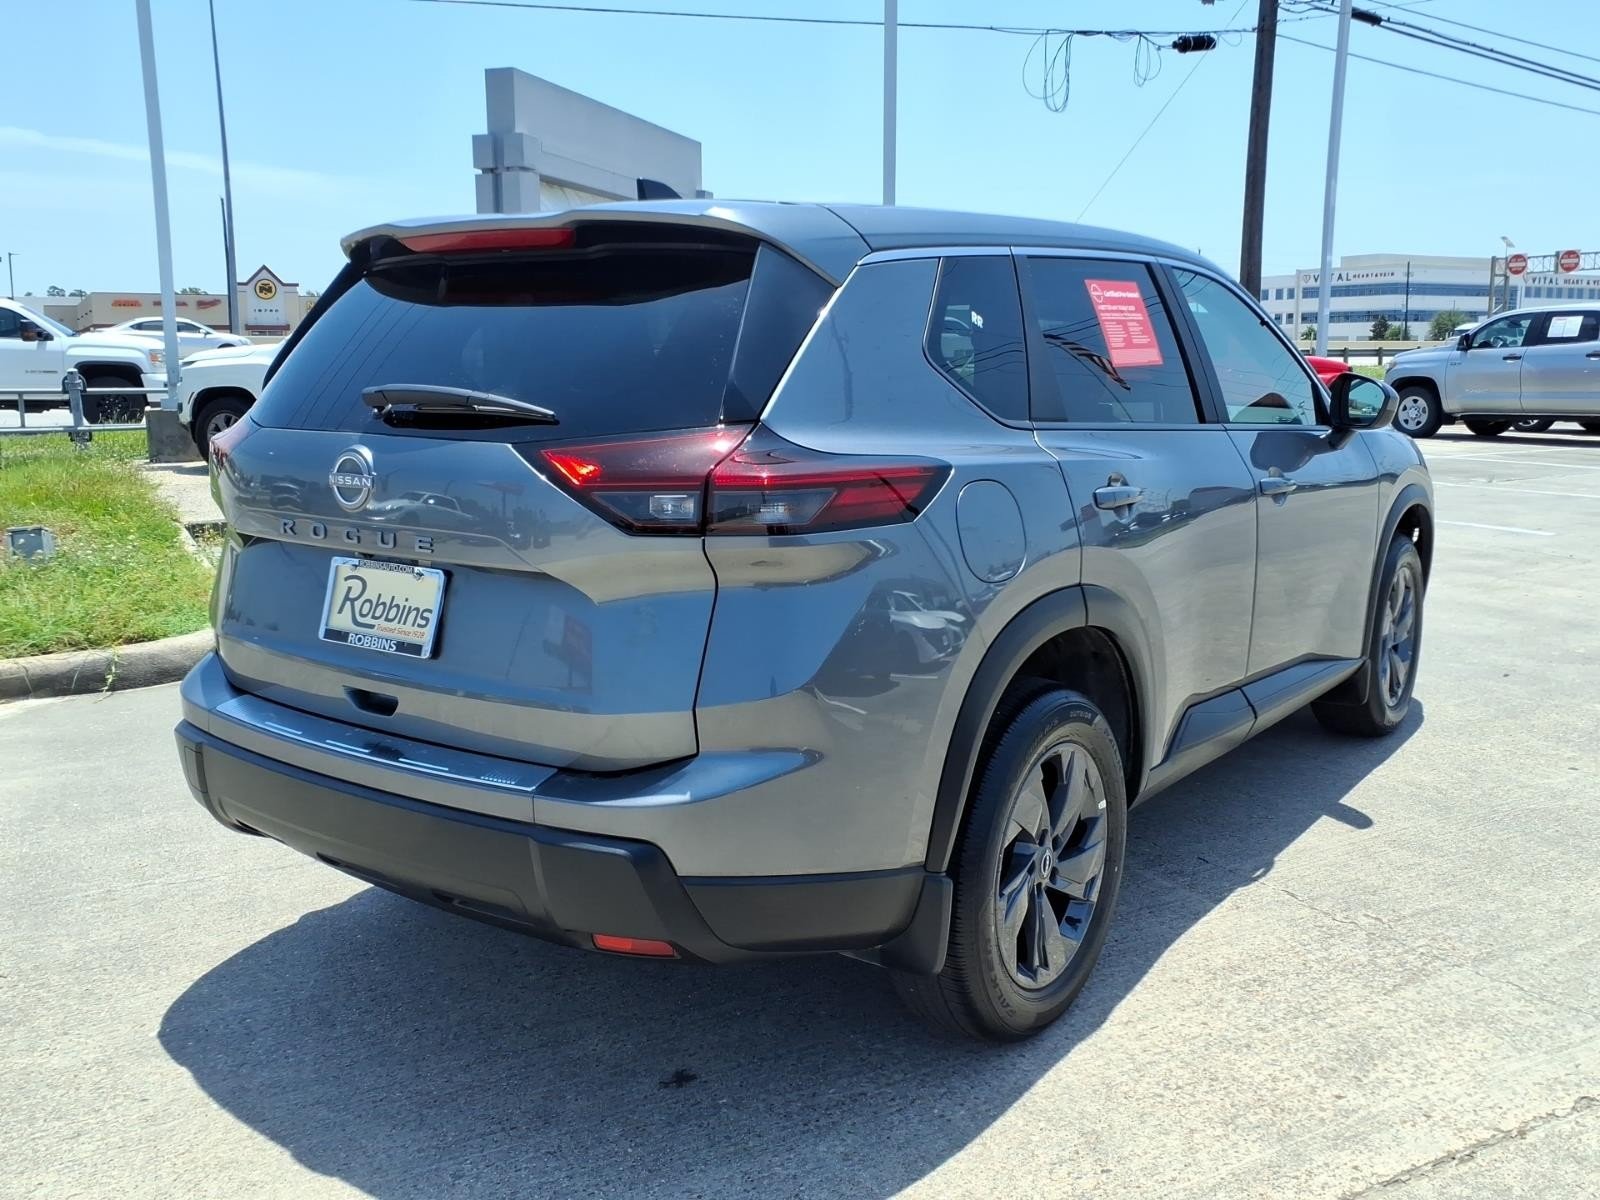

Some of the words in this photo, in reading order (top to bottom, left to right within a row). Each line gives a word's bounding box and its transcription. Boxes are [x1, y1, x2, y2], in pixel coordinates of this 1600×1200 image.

[1532, 276, 1559, 286] VITAL
[971, 311, 984, 329] RR
[328, 473, 371, 488] NISSAN
[279, 518, 435, 554] ROGUE
[359, 559, 415, 575] ROBBINSAUTO.COM
[337, 574, 433, 630] Robbins
[376, 623, 398, 634] Trusted
[397, 628, 411, 638] Since
[347, 633, 397, 652] ROBBINS
